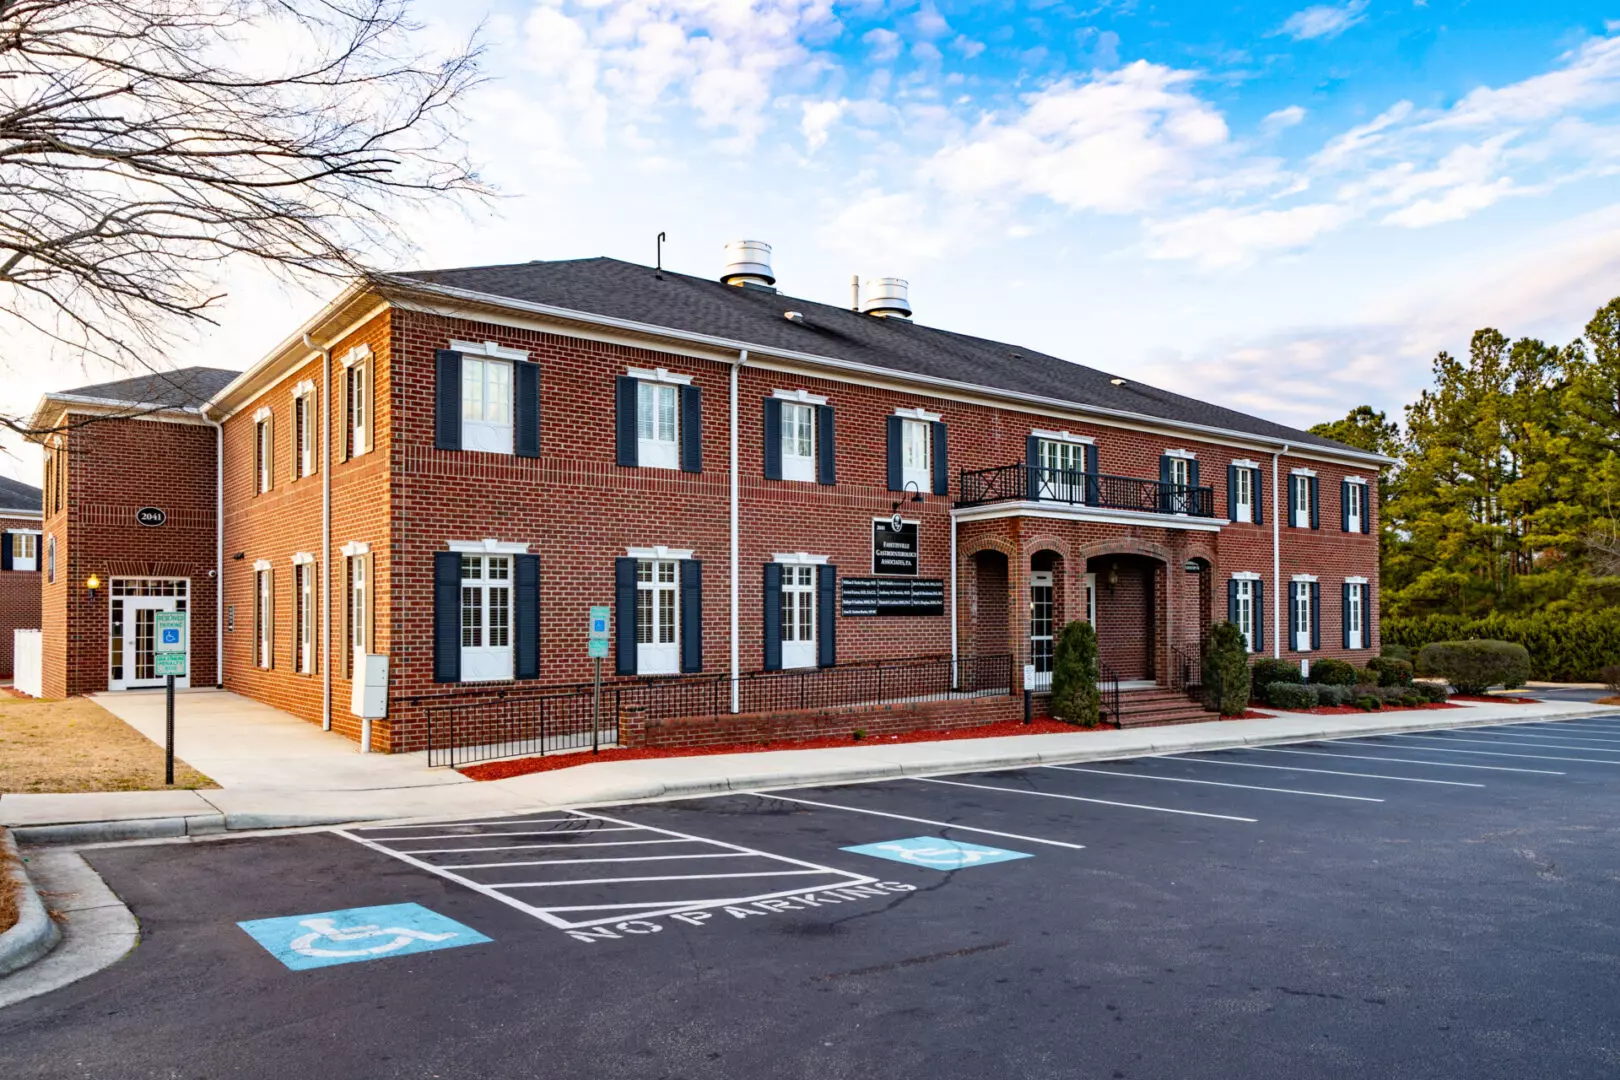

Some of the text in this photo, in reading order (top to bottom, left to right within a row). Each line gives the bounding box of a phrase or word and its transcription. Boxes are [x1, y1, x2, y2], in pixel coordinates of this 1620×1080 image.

[141, 512, 162, 520] 2041
[564, 881, 918, 942] NO PARKING
